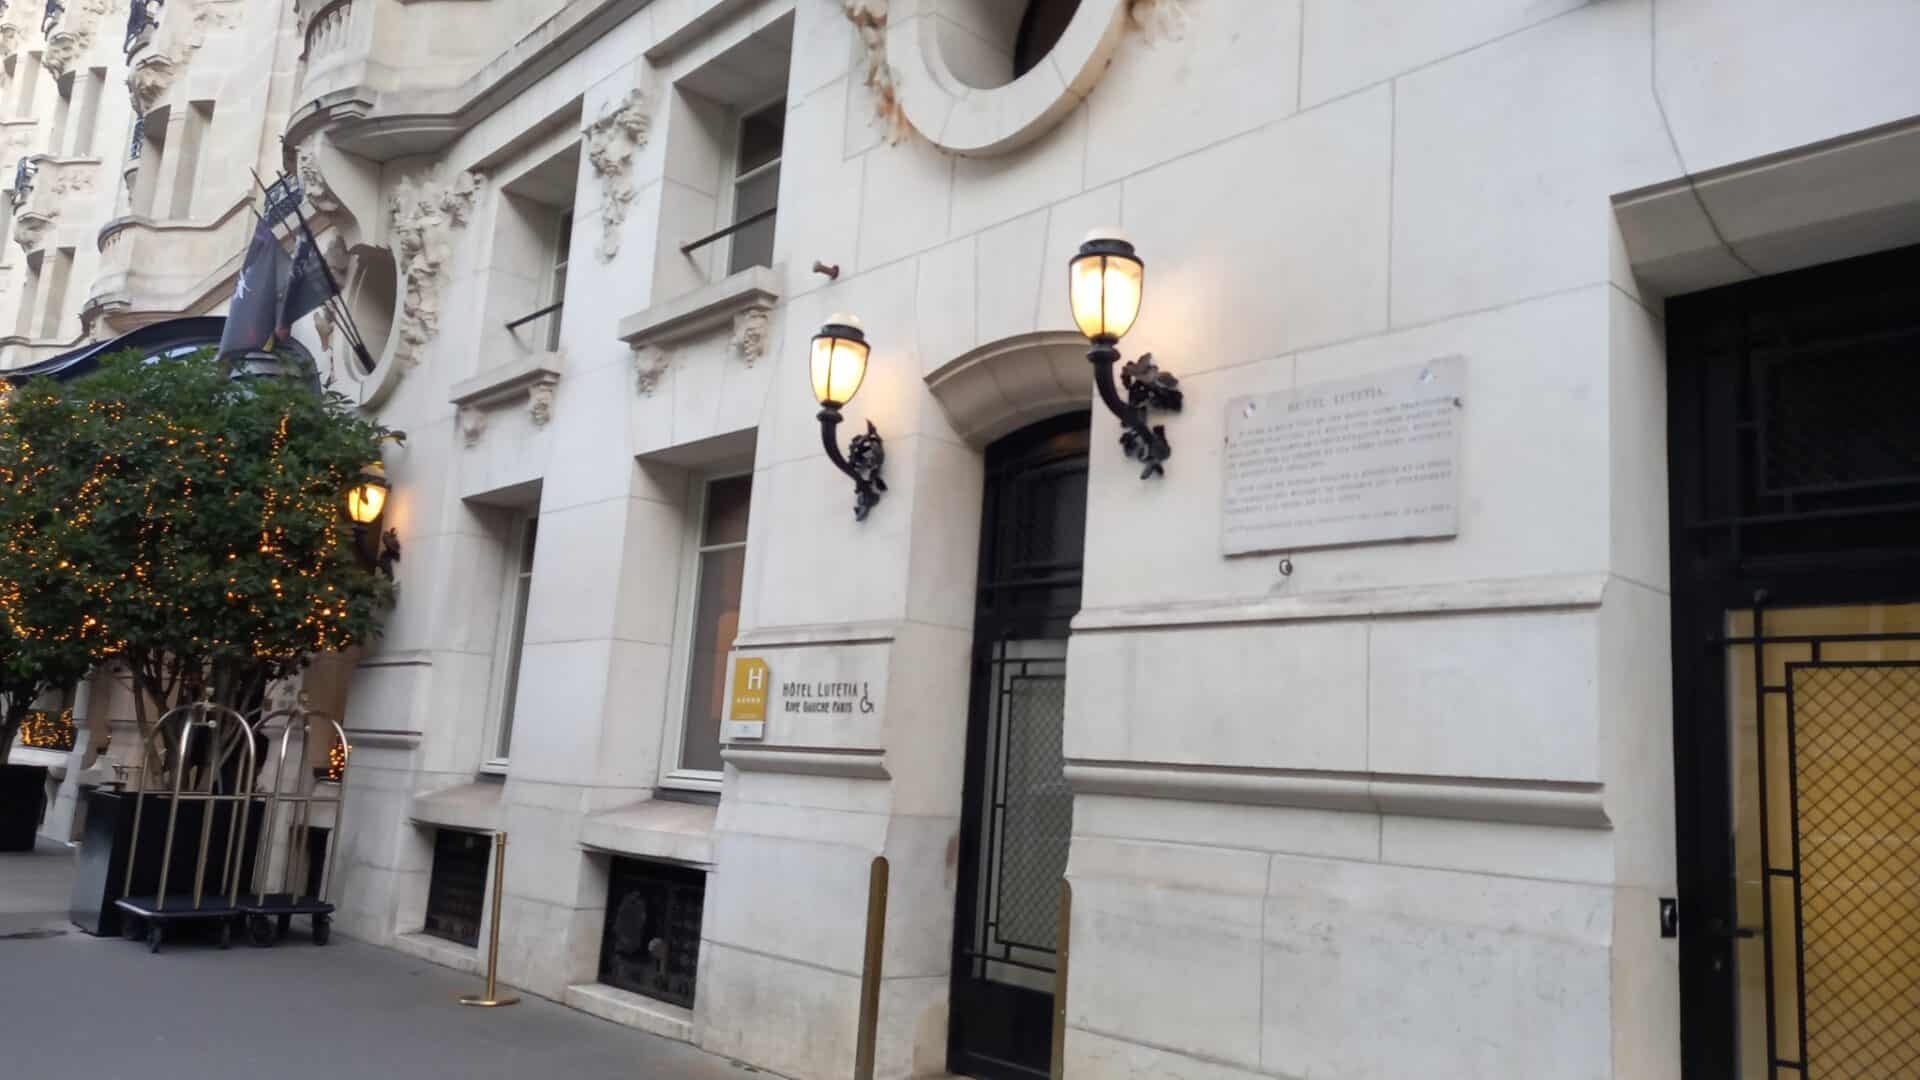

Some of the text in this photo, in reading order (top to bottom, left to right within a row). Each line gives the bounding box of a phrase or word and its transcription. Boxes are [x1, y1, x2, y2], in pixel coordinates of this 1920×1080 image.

[1333, 385, 1382, 405] LUTETIA
[748, 667, 763, 690] H
[782, 681, 812, 697] HÔTEL
[785, 701, 801, 713] RIVE
[832, 701, 853, 713] PARIS
